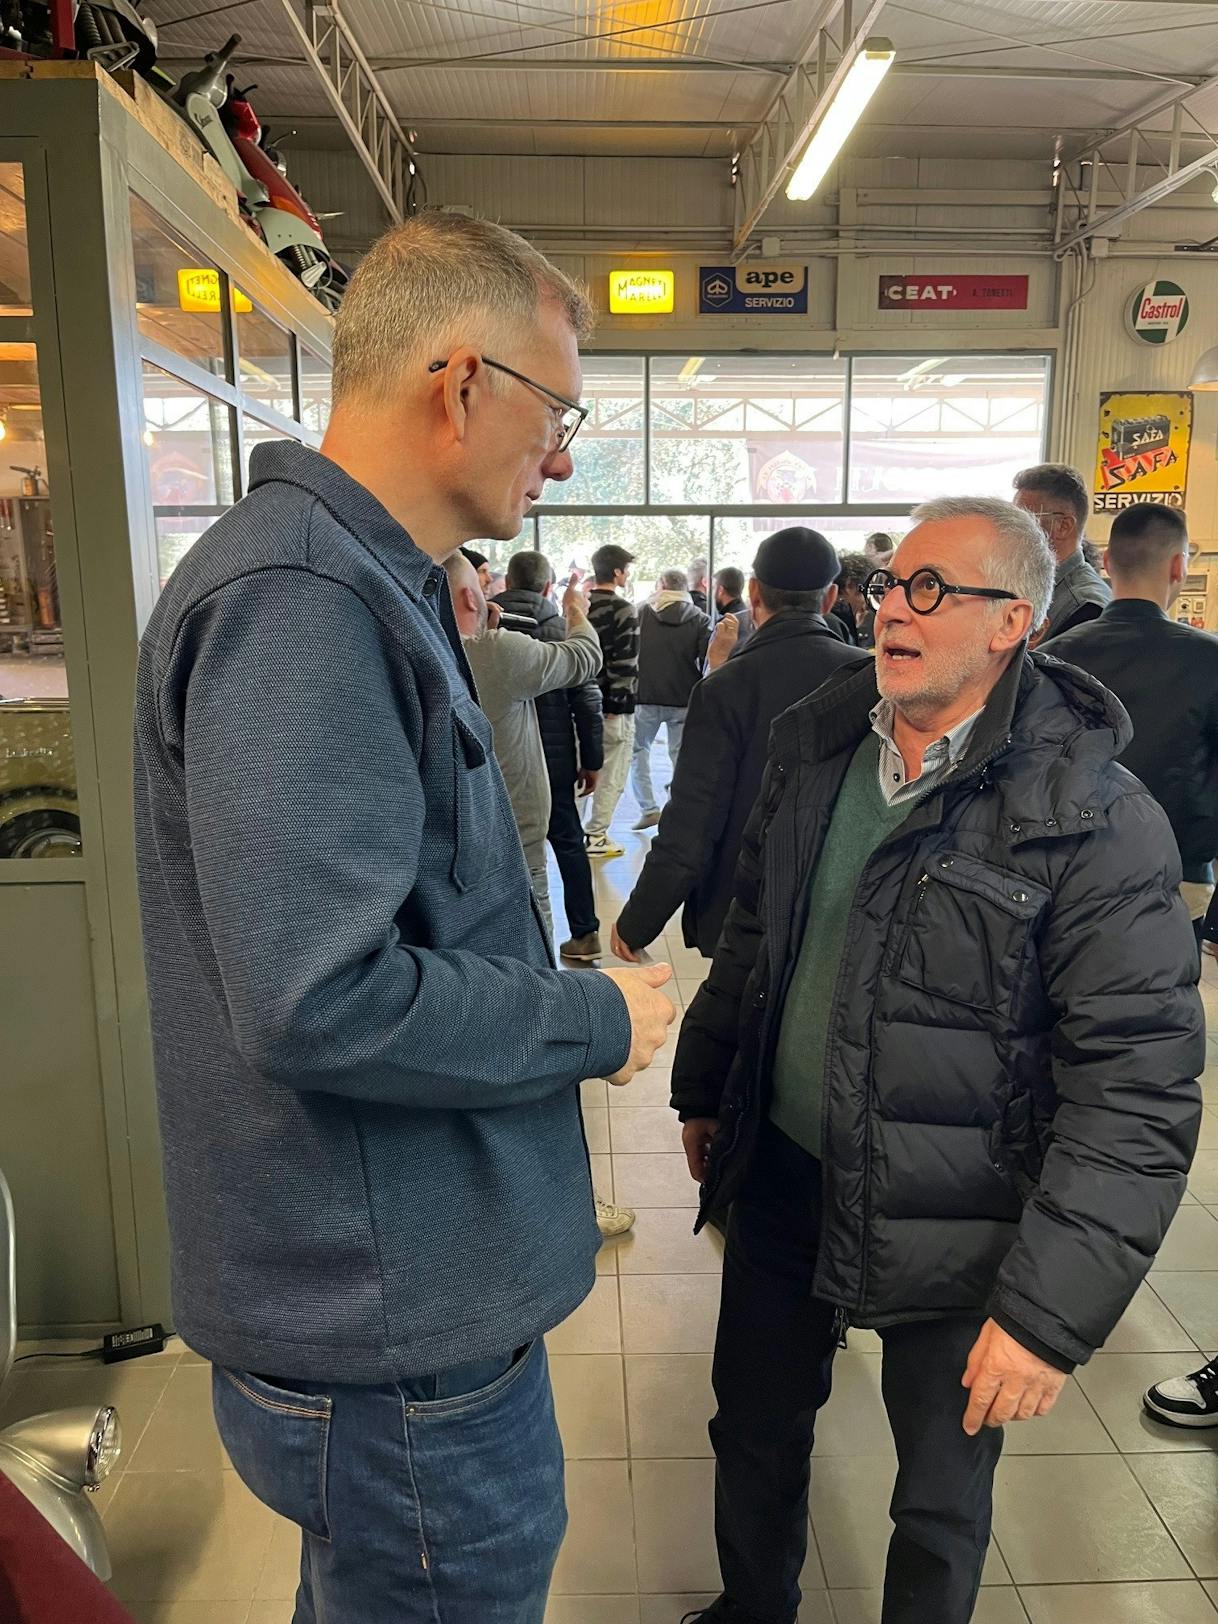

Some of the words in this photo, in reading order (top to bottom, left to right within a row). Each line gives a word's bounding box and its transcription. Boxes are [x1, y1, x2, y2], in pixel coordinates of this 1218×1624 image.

[745, 271, 794, 288] ape
[887, 285, 953, 300] CEAT
[745, 297, 794, 308] SERVIZIO
[1141, 297, 1183, 319] Castrol
[1131, 430, 1164, 447] SAFA
[1106, 450, 1178, 491] SAFA
